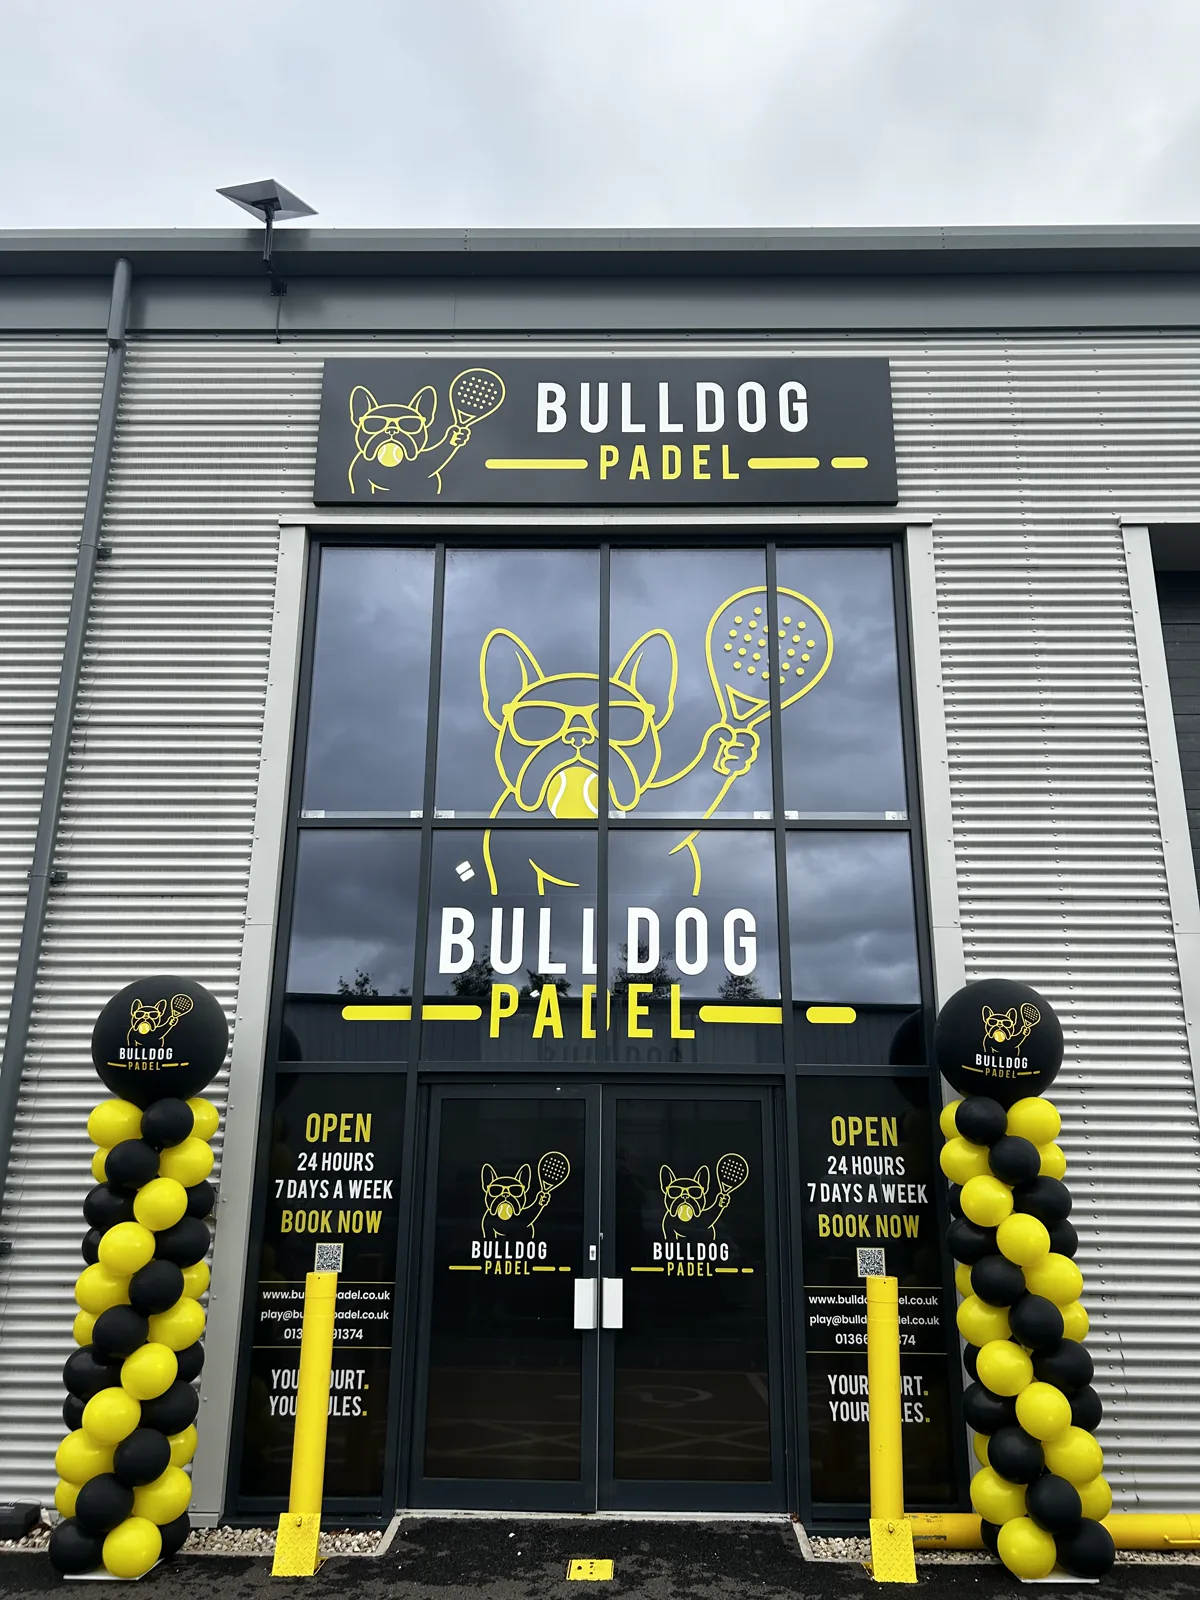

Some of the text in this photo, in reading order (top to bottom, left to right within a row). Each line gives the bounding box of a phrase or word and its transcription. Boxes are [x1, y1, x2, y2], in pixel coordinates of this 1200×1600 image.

[537, 382, 808, 433] BULLDOG
[600, 445, 739, 479] PADEL
[438, 907, 758, 976] BULLDOG
[488, 983, 696, 1039] PADEL
[119, 1047, 173, 1060] BULLDOG
[975, 1053, 1028, 1069] BULLDOG
[128, 1061, 161, 1071] PADEL
[985, 1067, 1017, 1079] PADEL
[306, 1113, 371, 1142] OPEN
[832, 1116, 897, 1146] OPEN
[297, 1152, 374, 1171] 24 HOURS
[828, 1156, 905, 1175] 24 HOURS
[276, 1180, 393, 1199] 7 DAYS A WEEK
[808, 1183, 928, 1204] 7 DAYS A WEEK
[281, 1210, 382, 1233] BOOK NOW
[819, 1214, 919, 1238] BOOK NOW
[472, 1241, 546, 1259] BULLDOG
[654, 1242, 728, 1261] BULLDOG
[484, 1260, 531, 1275] PADEL
[668, 1262, 712, 1276] PADEL
[262, 1289, 391, 1300] www.buadel.co.uk
[808, 1294, 938, 1305] www.bulldel.co.uk
[260, 1309, 390, 1322] play@buadel.co.uk
[809, 1314, 940, 1327] play@bulldel.co.uk
[271, 1369, 299, 1390] YOU
[827, 1374, 869, 1395] YOUR
[269, 1396, 298, 1416] YOU
[829, 1401, 869, 1422] YOUR
